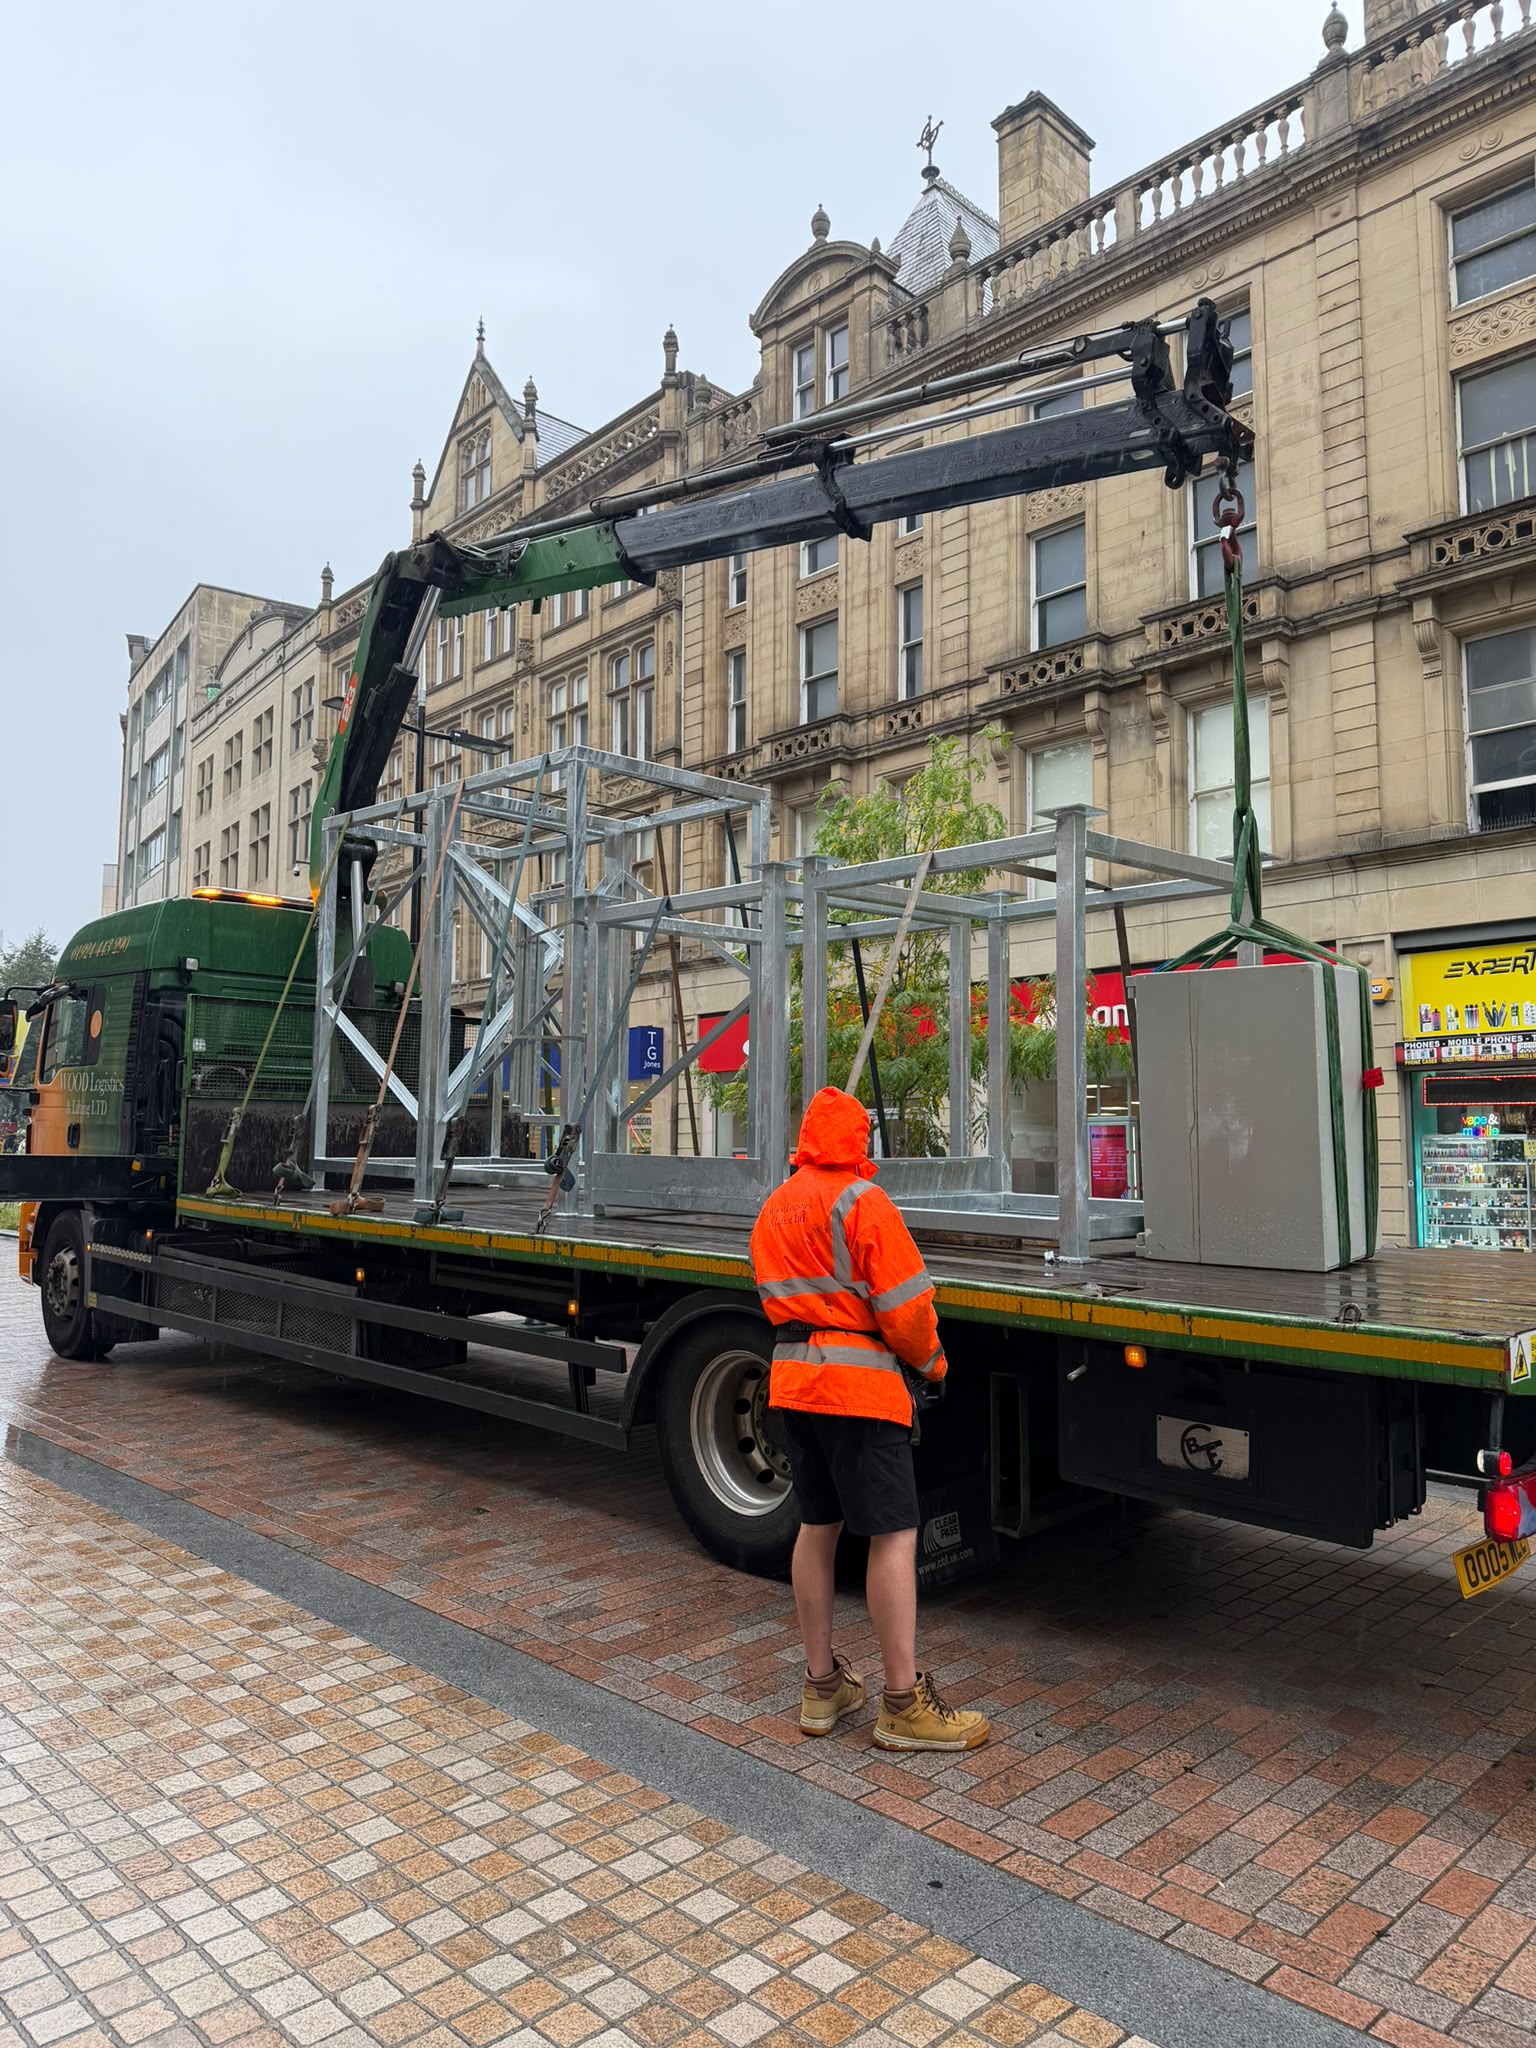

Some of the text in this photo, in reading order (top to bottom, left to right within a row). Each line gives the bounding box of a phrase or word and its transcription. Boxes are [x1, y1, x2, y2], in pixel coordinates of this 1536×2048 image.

[1443, 947, 1536, 979] EXPERT
[1404, 1040, 1440, 1049] PHONES
[1447, 1038, 1482, 1047] MOBILE
[1484, 1035, 1524, 1044] PHONES
[643, 1060, 661, 1069] Jones
[60, 1071, 124, 1096] WOOD Logistics
[91, 1100, 108, 1116] LTD
[1461, 1113, 1499, 1126] vape &
[1462, 1125, 1499, 1136] mobile
[935, 1514, 957, 1530] CLEAR
[941, 1525, 959, 1539] PASS
